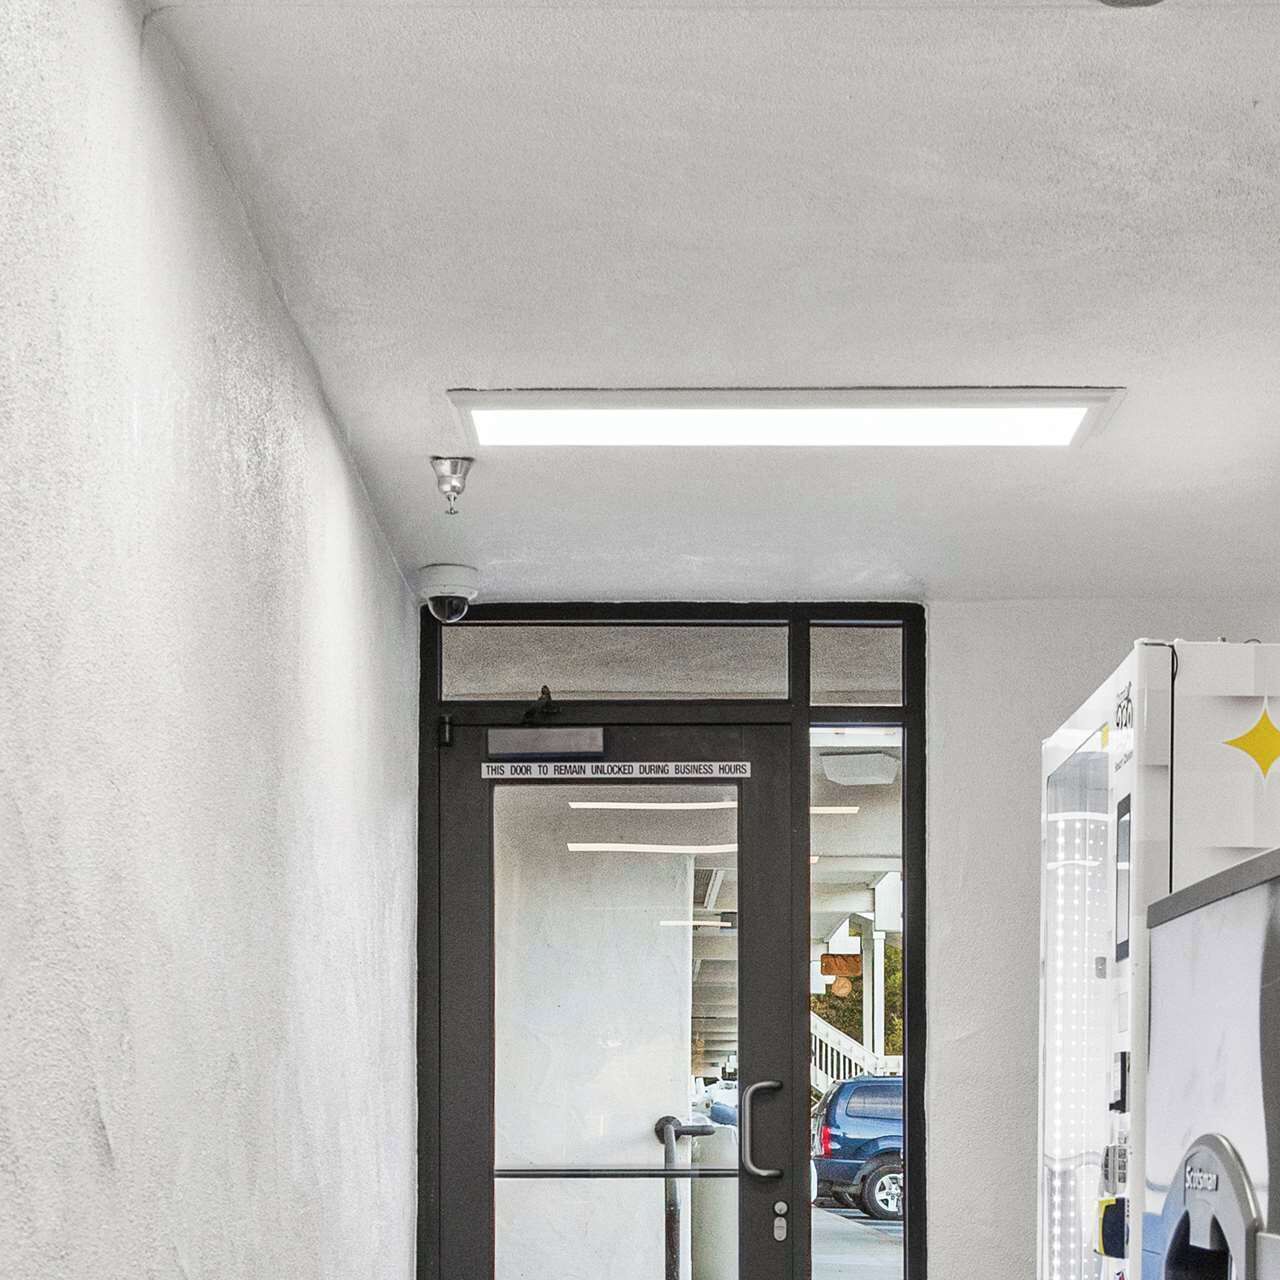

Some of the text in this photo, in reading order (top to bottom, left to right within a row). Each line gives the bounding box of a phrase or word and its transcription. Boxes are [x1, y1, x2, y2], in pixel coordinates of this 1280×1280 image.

[486, 763, 747, 776] THIS DOOR TO REMAIN UNLOCKED DURING BUSINESS HOURS
[1185, 1166, 1219, 1191] Scotsman
